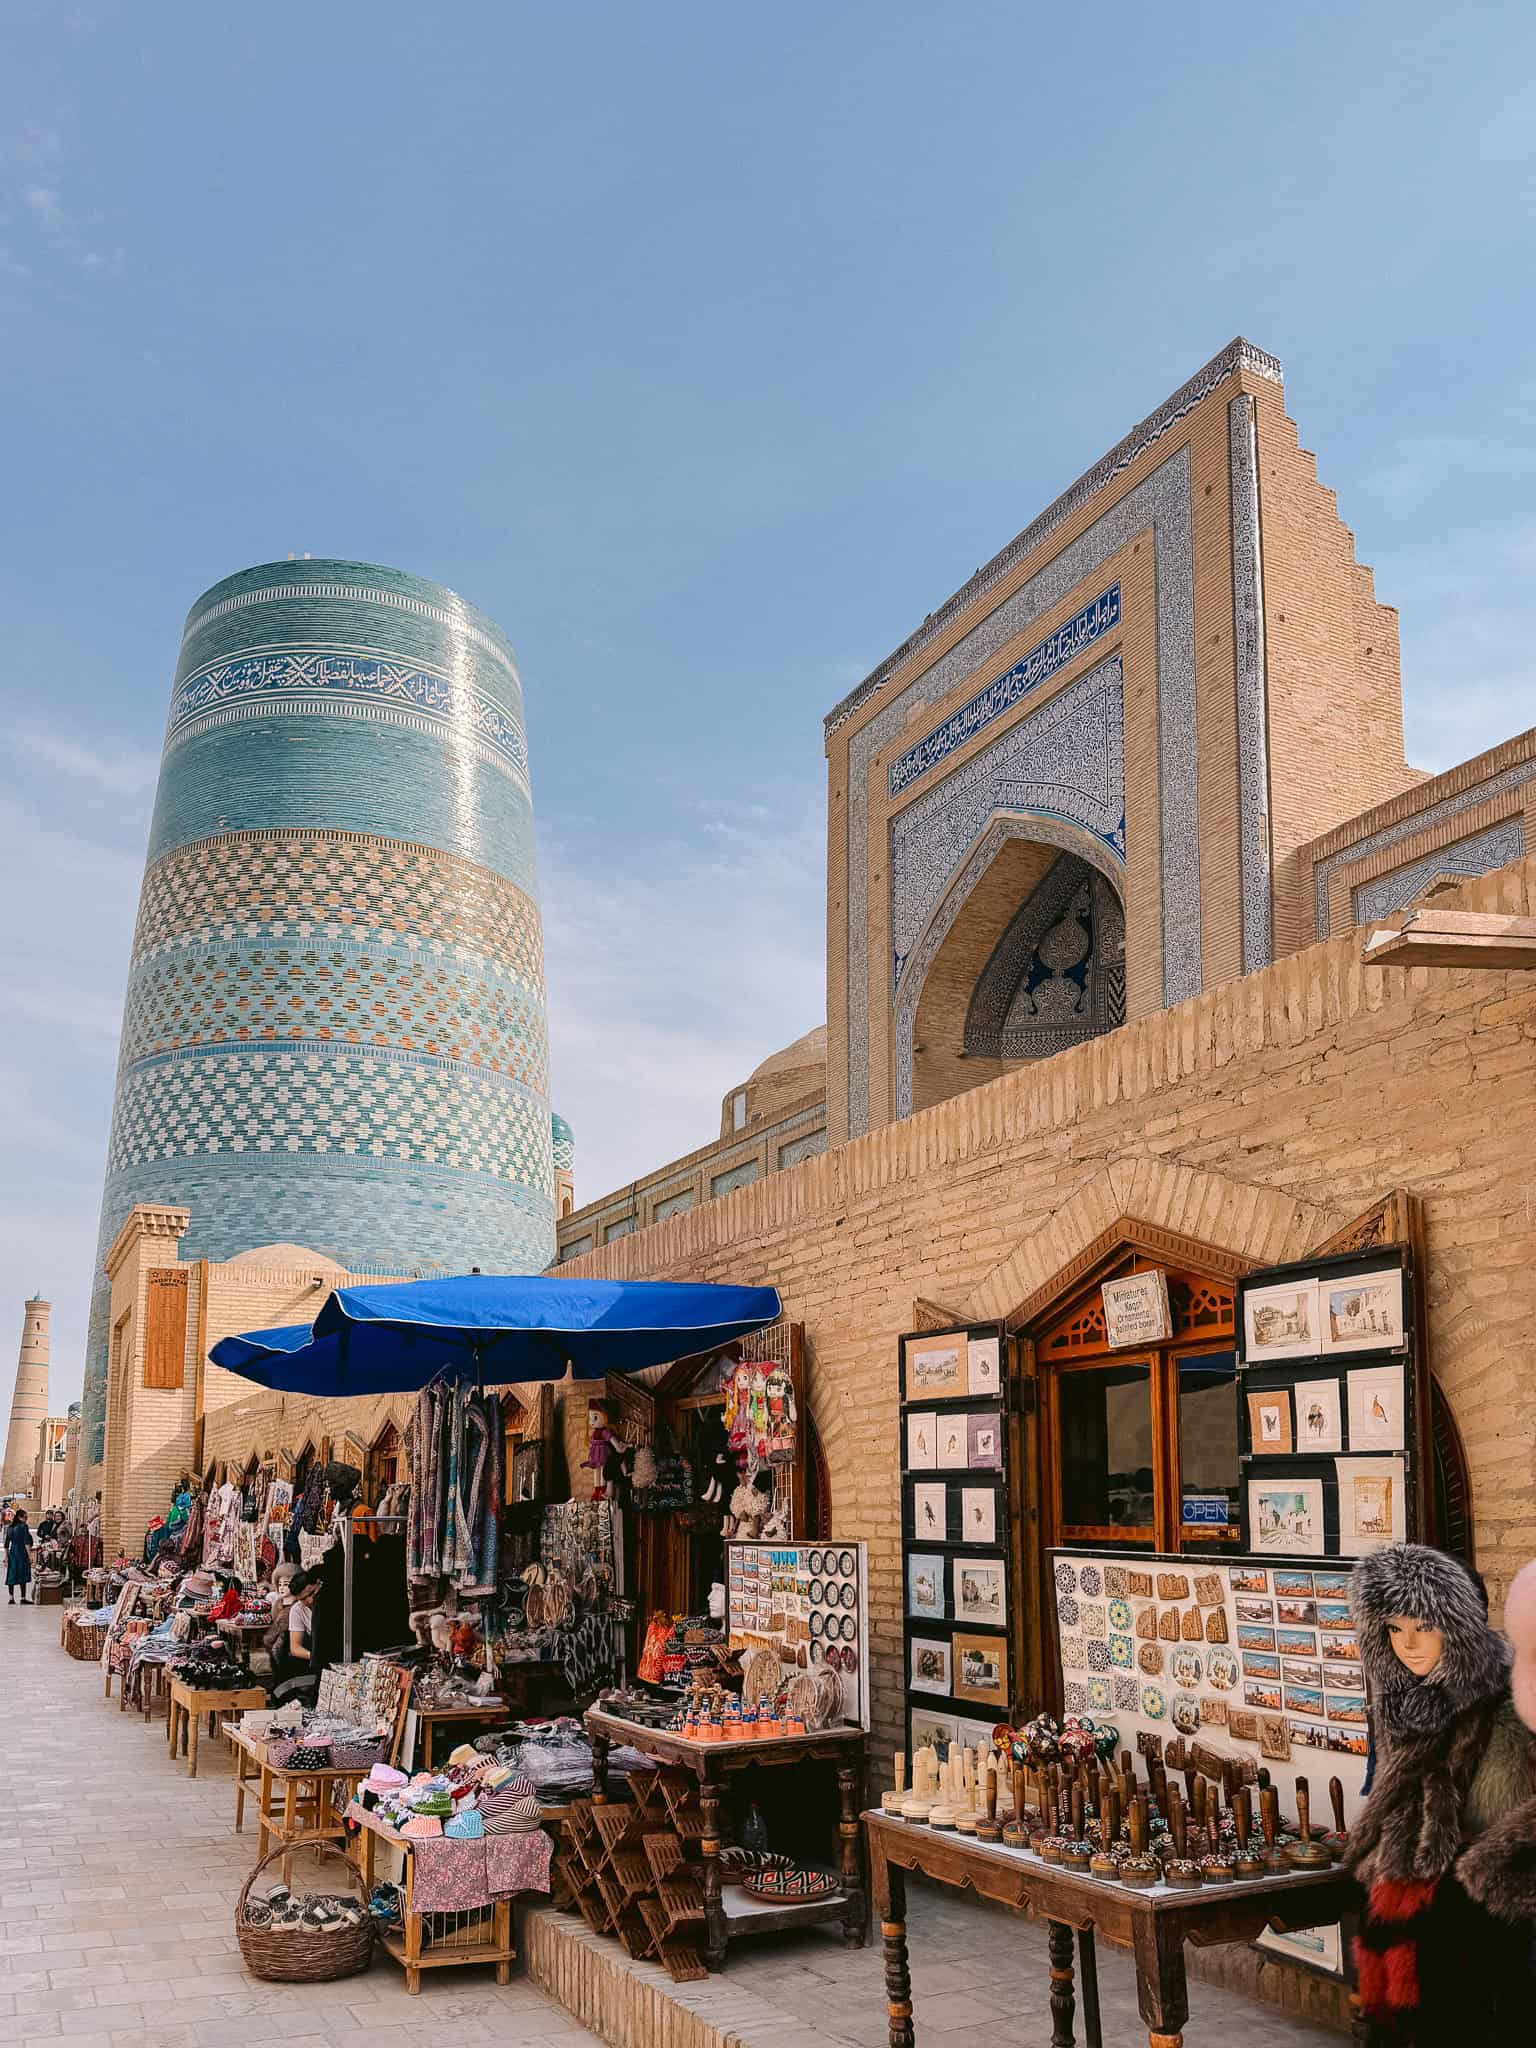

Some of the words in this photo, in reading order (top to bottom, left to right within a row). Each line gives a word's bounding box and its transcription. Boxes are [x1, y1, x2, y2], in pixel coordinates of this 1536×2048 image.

[1113, 1287, 1148, 1303] Miniatures
[1116, 1322, 1138, 1336] painted
[1183, 1502, 1229, 1520] OPEN
